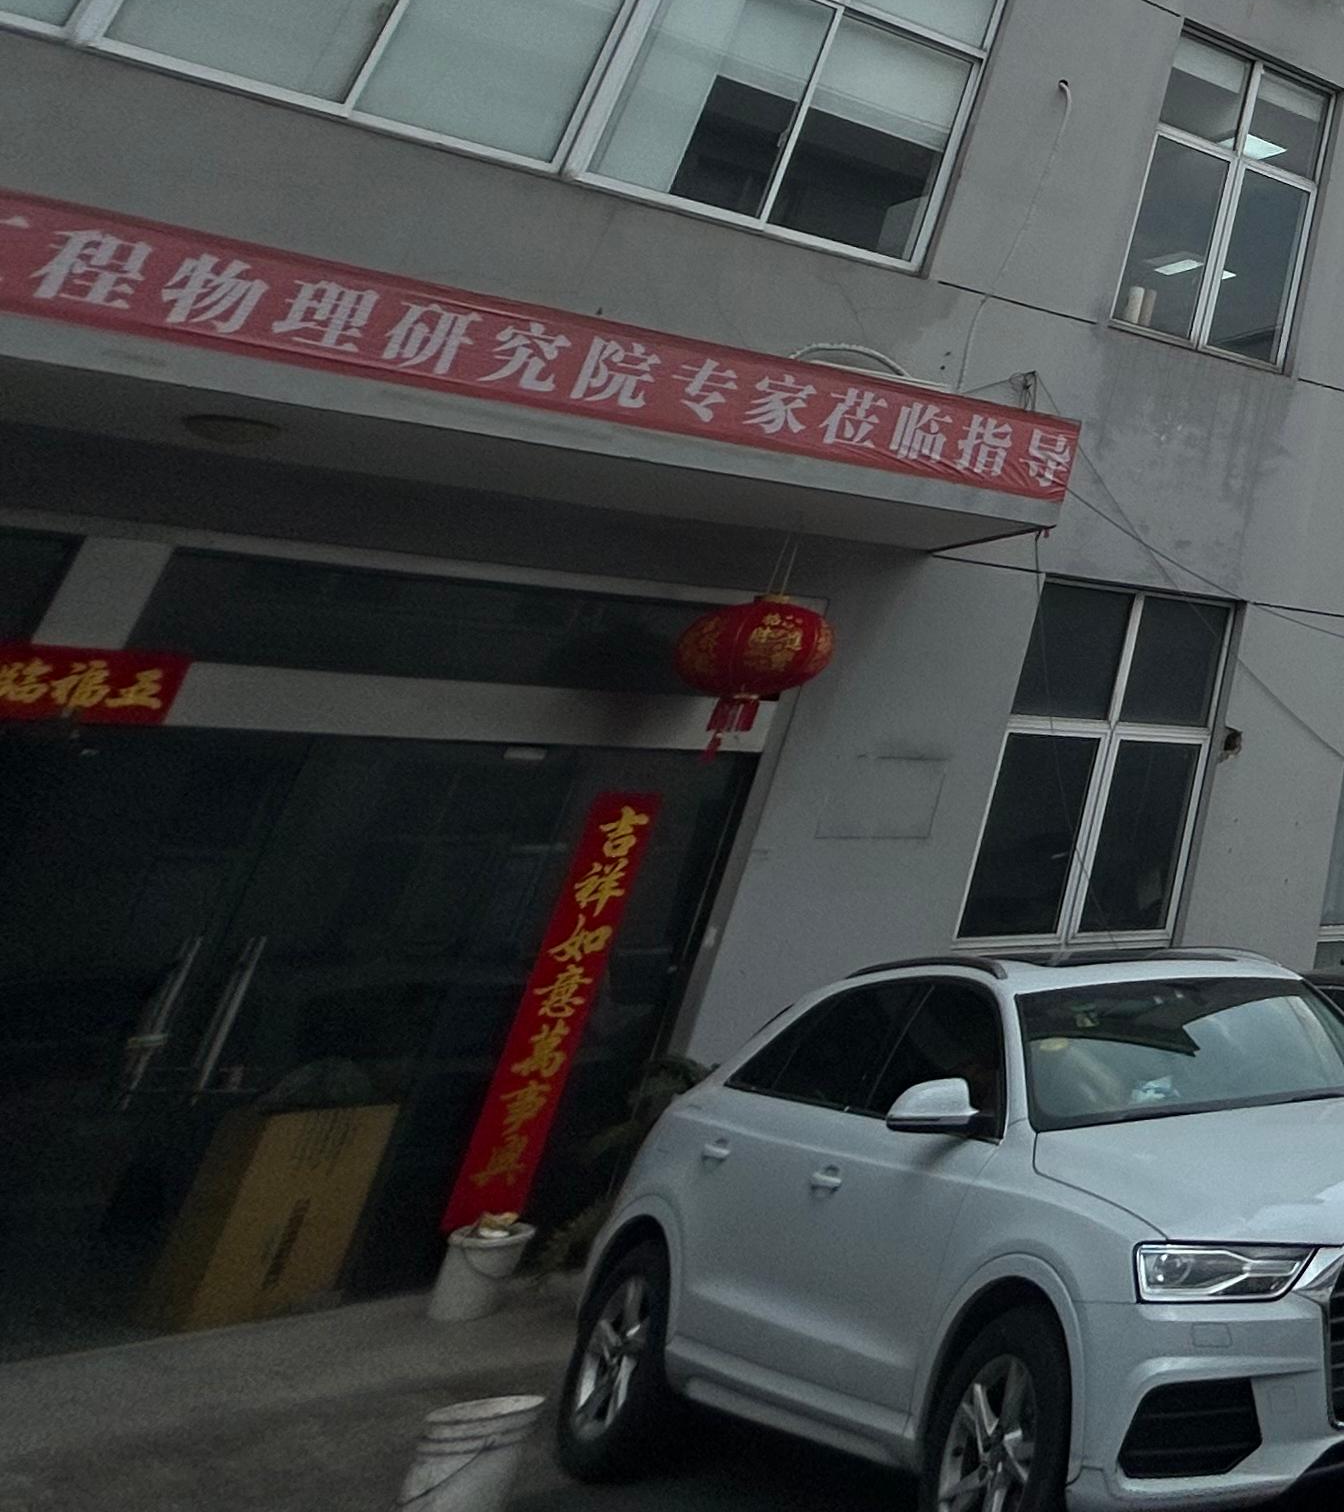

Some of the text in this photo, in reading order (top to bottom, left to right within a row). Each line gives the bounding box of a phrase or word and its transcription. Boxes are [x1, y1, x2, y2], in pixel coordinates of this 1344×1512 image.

[0, 215, 1073, 487] 程物理研究院专家莅临指导
